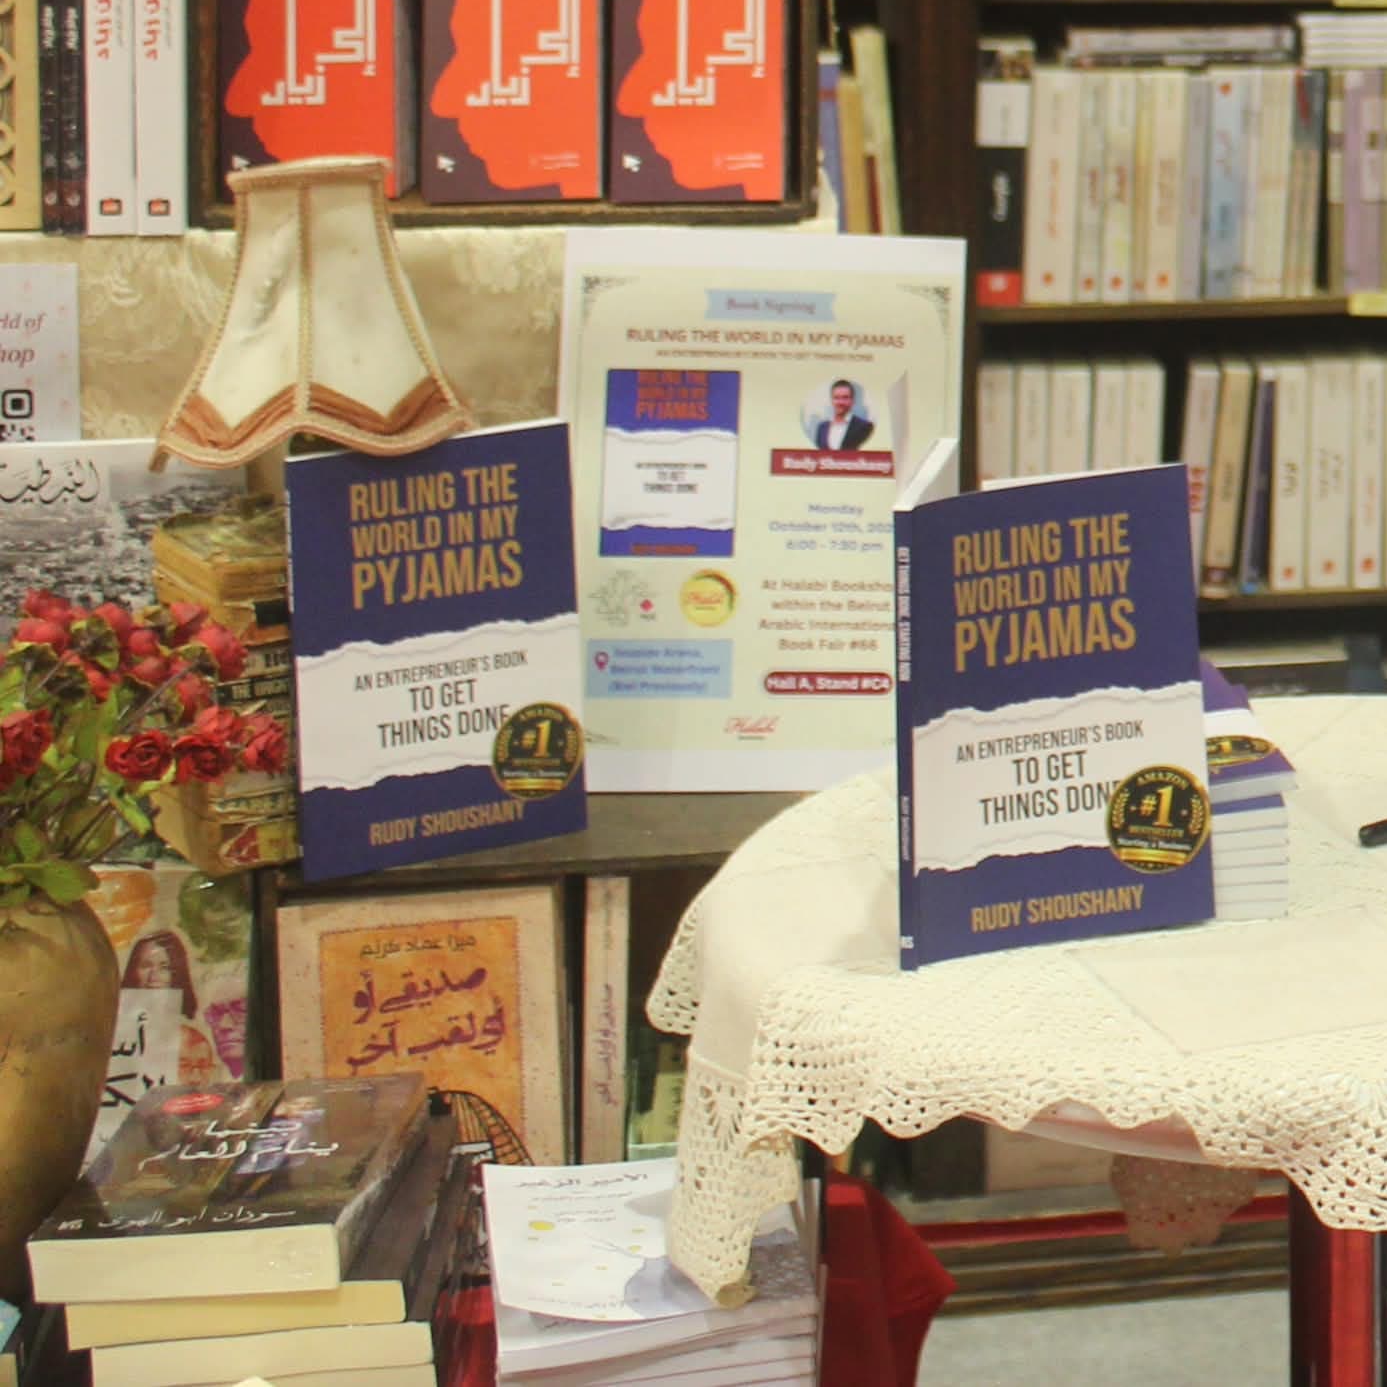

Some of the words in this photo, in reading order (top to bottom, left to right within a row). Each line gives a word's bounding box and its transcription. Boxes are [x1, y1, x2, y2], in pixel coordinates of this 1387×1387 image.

[0, 311, 22, 331] rld
[24, 311, 45, 334] of
[727, 298, 761, 311] Book
[765, 299, 816, 314] Signing
[626, 328, 687, 342] RULING
[692, 329, 719, 342] THE
[725, 330, 783, 344] WORLD
[788, 331, 804, 344] IN
[809, 332, 831, 345] MY
[837, 333, 905, 351] PYJAMAS
[350, 477, 455, 521] RULING
[463, 463, 518, 504] THE
[809, 503, 863, 515] Monday
[352, 517, 442, 558] WORLD
[448, 511, 473, 545] IN
[480, 504, 518, 539] MY
[953, 520, 1062, 577] RULING
[1071, 513, 1131, 558] THE
[353, 541, 523, 609] PYJAMAS
[831, 580, 894, 591] Booksho
[954, 570, 1047, 616] WORLD
[1054, 565, 1081, 602] IN
[1090, 558, 1131, 596] MY
[779, 638, 815, 651] Book
[819, 638, 845, 651] Fair
[954, 598, 1135, 672] PYJAMAS
[355, 674, 372, 691] AN
[377, 655, 489, 688] ENTREPRENEUR'S
[495, 649, 528, 669] BOOK
[766, 677, 796, 690] Hall
[816, 677, 858, 690] Stand
[410, 687, 433, 712] TO
[442, 679, 477, 706] GET
[379, 715, 450, 749] THINGS
[520, 718, 551, 759] #1
[957, 743, 973, 763] AN
[979, 726, 1102, 759] ENTREPRENEUR'S
[1106, 719, 1144, 742] BOOK
[1012, 756, 1040, 786] TO
[1047, 750, 1087, 781] GET
[1135, 768, 1190, 790] AMAZON
[370, 814, 415, 847] RUDY
[422, 799, 525, 838] SHOUSHANY
[979, 788, 1058, 827] THINGS
[1140, 784, 1173, 829] #1
[971, 900, 1022, 933] RUDY
[1028, 885, 1144, 922] SHOUSHANY
[353, 969, 375, 1025] أو
[380, 968, 487, 1013] صديقي
